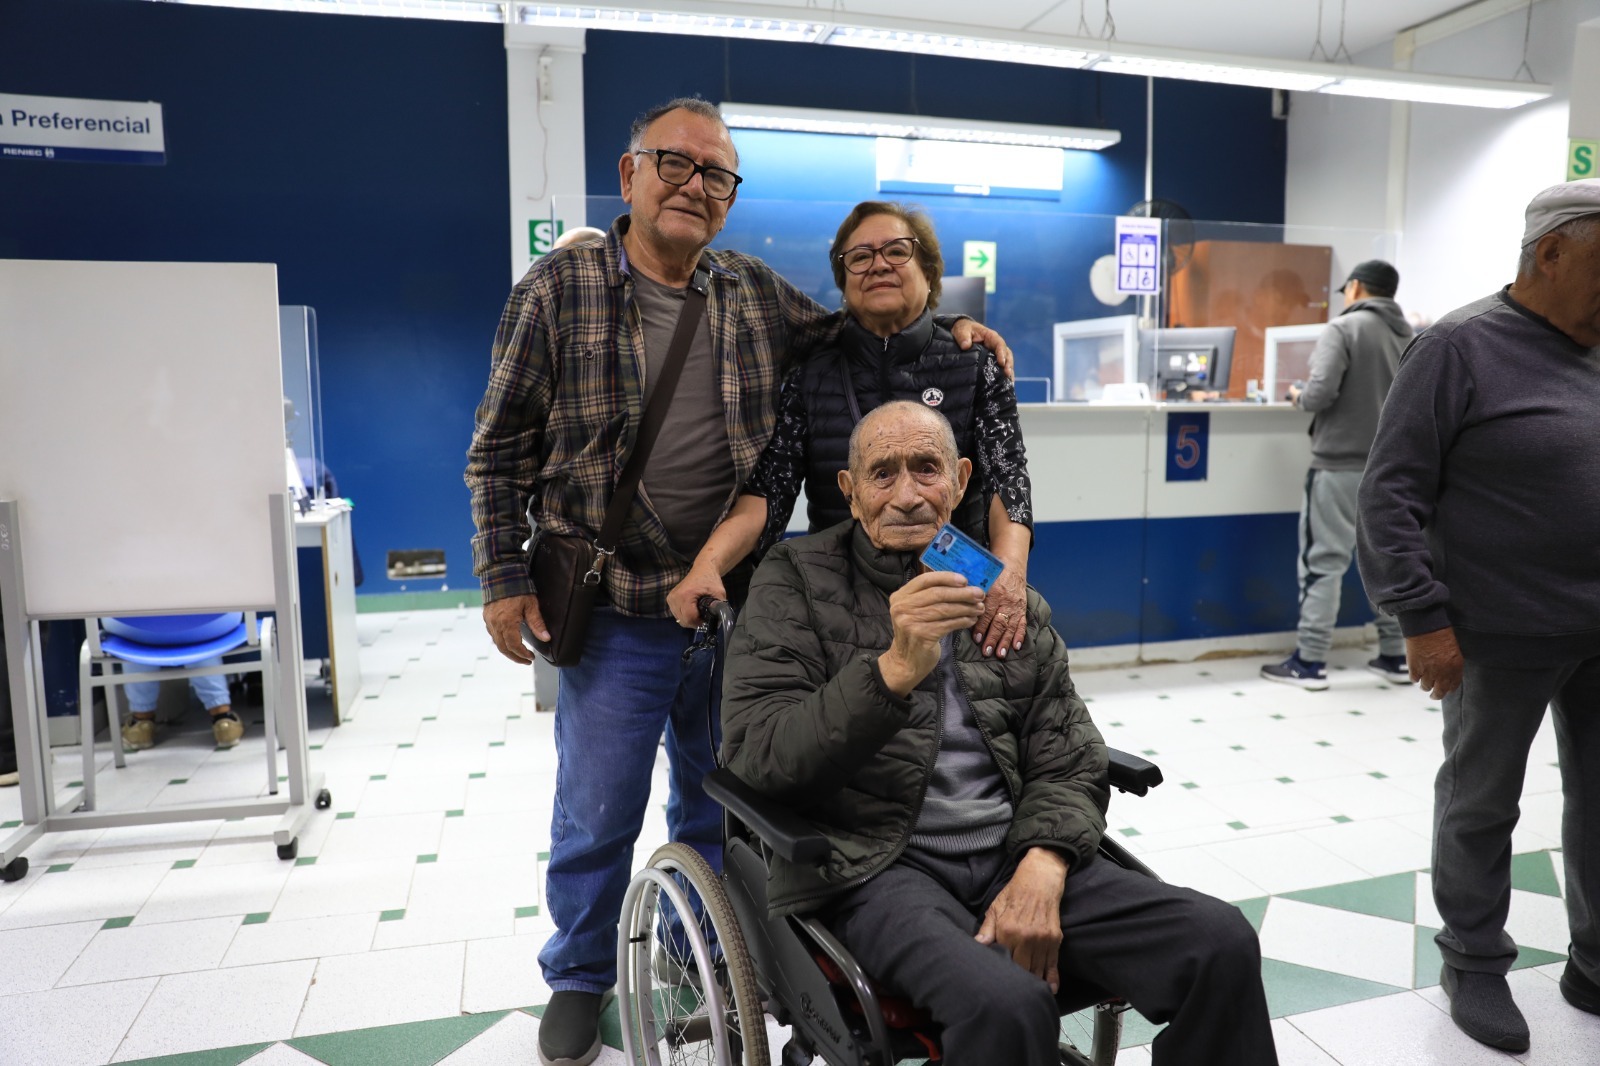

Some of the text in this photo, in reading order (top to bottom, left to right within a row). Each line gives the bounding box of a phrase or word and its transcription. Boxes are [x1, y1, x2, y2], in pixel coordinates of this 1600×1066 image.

[11, 109, 150, 133] Preferencial
[1573, 145, 1592, 176] S
[533, 222, 556, 254] S
[1175, 424, 1200, 469] 5
